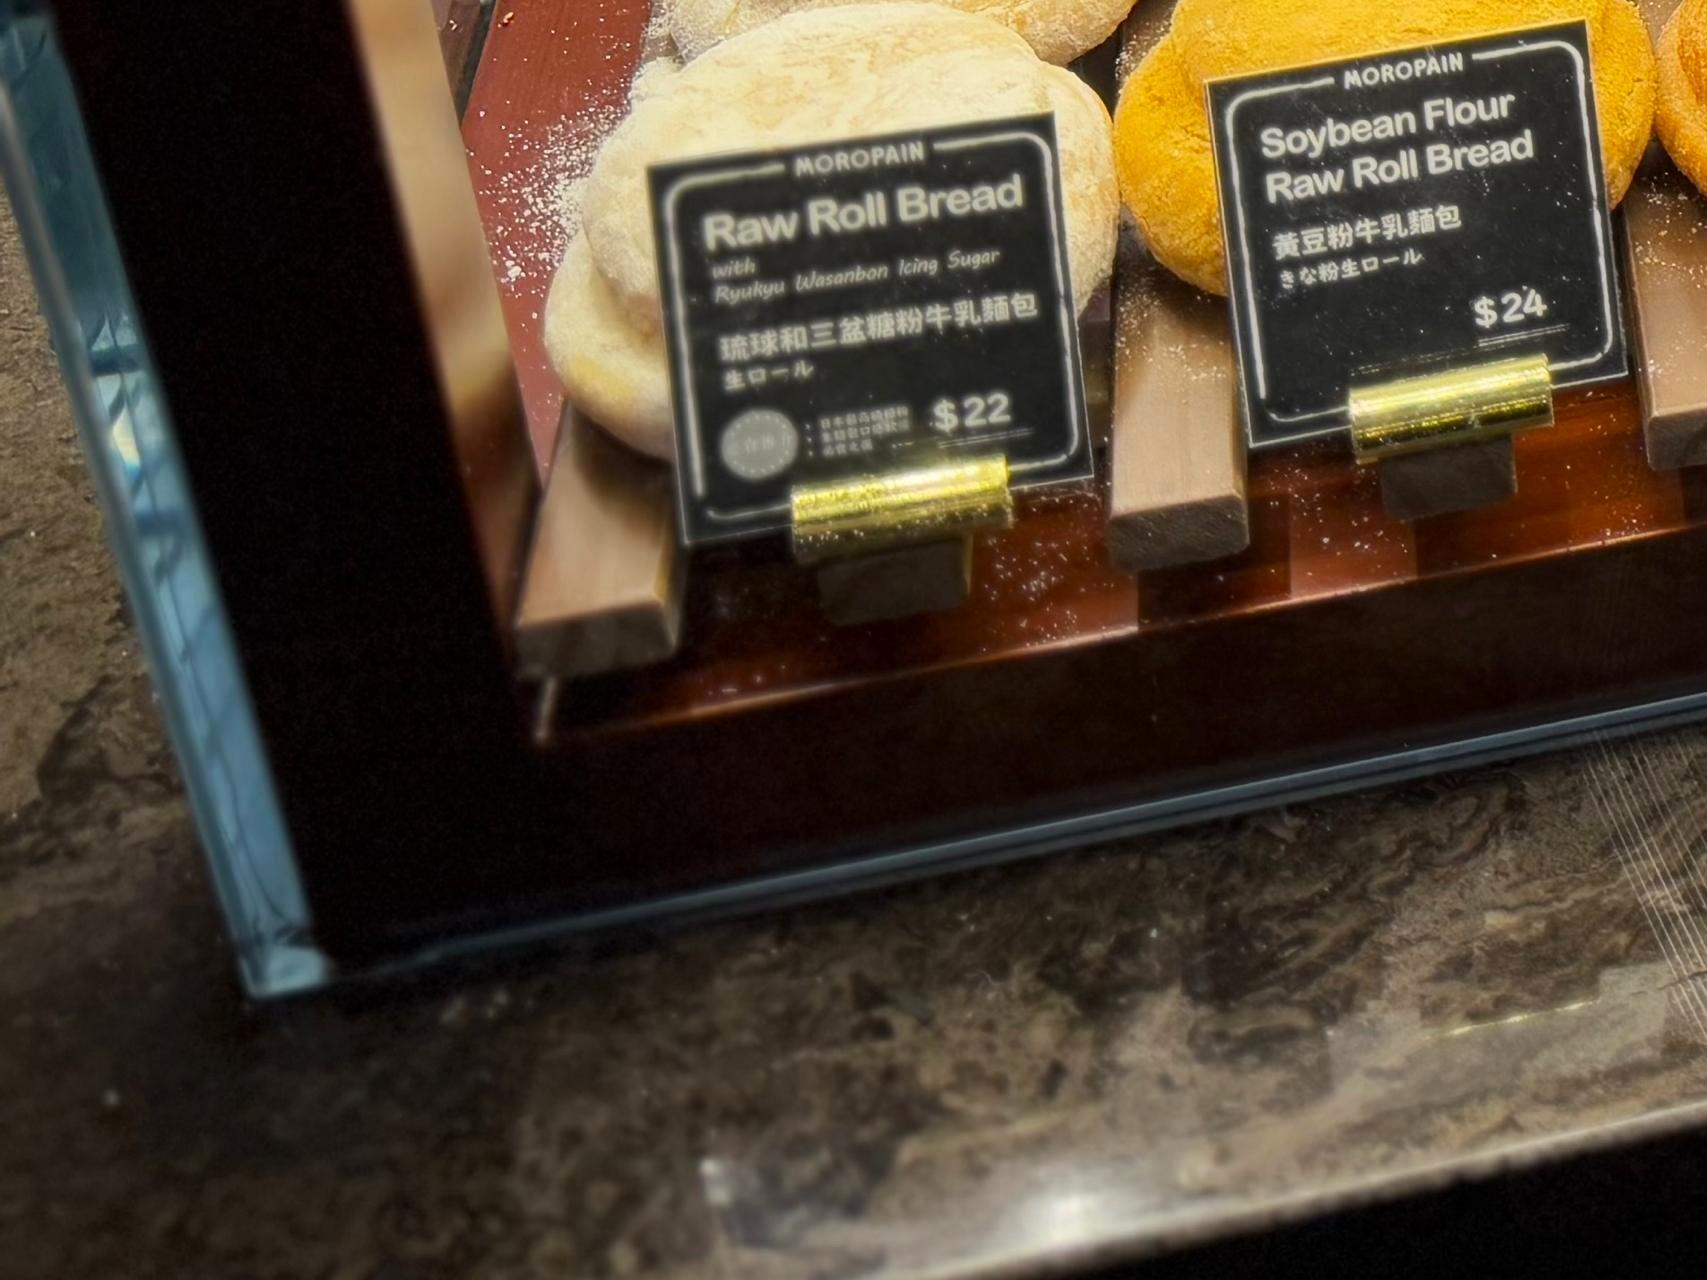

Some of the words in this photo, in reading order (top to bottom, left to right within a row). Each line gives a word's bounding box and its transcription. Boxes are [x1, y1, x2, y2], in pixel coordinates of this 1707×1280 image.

[1343, 52, 1464, 89] MOROPAIN
[1260, 109, 1417, 159] Soybean
[1424, 92, 1516, 129] Flour
[795, 142, 925, 178] MOROPAIN
[1265, 167, 1345, 204] Raw
[1352, 148, 1419, 190] Roll
[1426, 129, 1534, 175] Bread
[704, 207, 799, 250] Raw
[808, 192, 888, 237] Roll
[898, 173, 1025, 223] Bread
[711, 258, 757, 278] with
[713, 278, 786, 305] Ryukyu
[796, 262, 889, 291] Wasanbon
[899, 256, 939, 277] Icing
[947, 248, 1001, 271] Sugar
[1279, 249, 1424, 289] きな粉生ロール
[1472, 288, 1547, 328] $24
[722, 361, 814, 392] 生ロール
[931, 393, 1012, 435] $22
